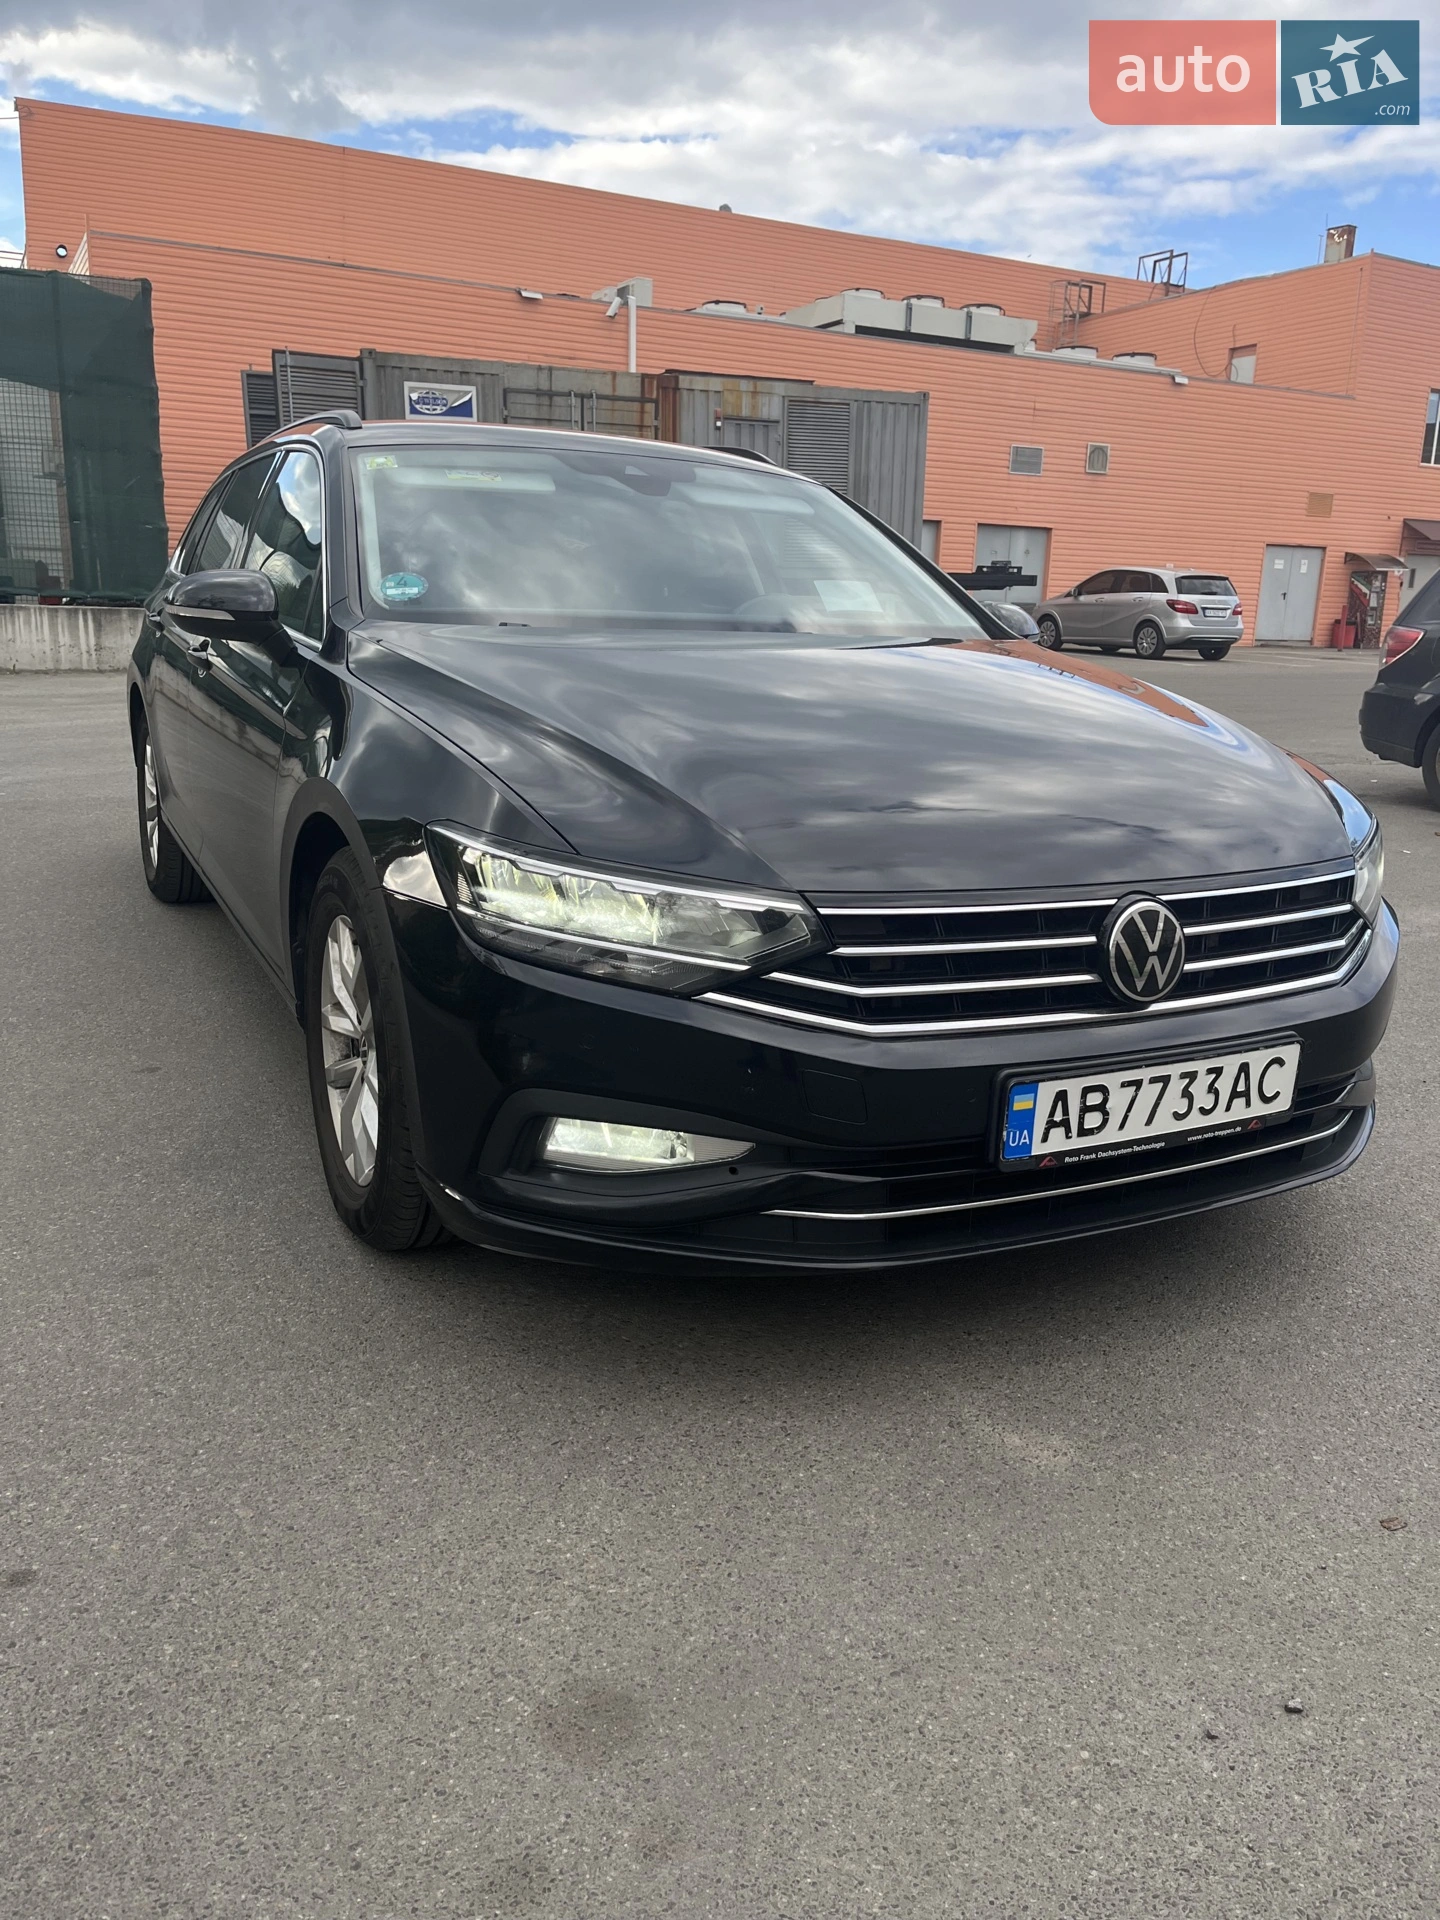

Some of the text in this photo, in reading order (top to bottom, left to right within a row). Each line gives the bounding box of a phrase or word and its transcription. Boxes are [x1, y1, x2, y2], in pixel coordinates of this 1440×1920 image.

[396, 576, 408, 587] 4
[1040, 1055, 1287, 1144] AB7733AC
[1008, 1129, 1031, 1147] UA
[1079, 1153, 1097, 1161] Frank
